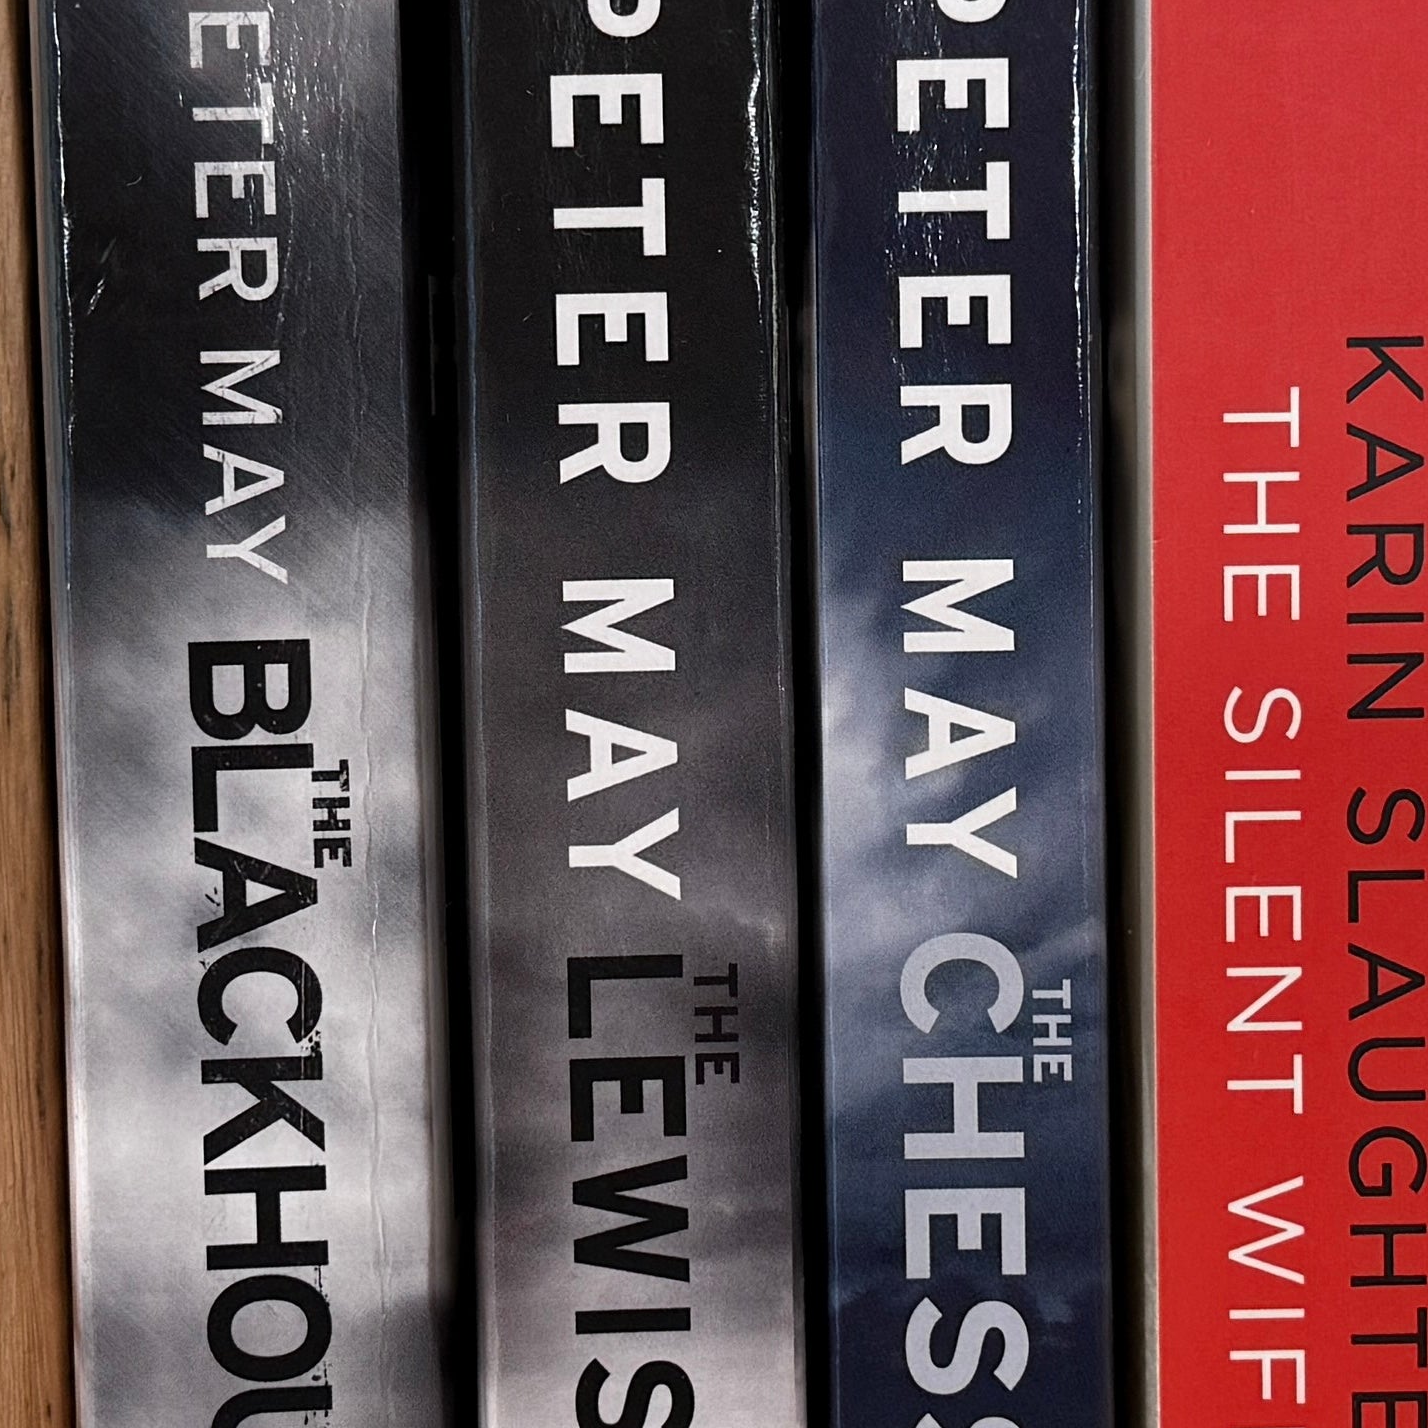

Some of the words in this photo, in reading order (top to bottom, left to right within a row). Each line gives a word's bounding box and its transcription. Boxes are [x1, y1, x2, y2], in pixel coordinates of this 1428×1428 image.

[197, 347, 290, 585] MAY
[1222, 386, 1303, 622] THE
[1344, 333, 1427, 724] KARIN
[311, 760, 352, 869] THE
[560, 577, 683, 900] MAY
[900, 558, 1020, 880] MAY
[1222, 684, 1306, 1114] SILENT
[697, 962, 740, 1085] THE
[1030, 978, 1074, 1083] THE
